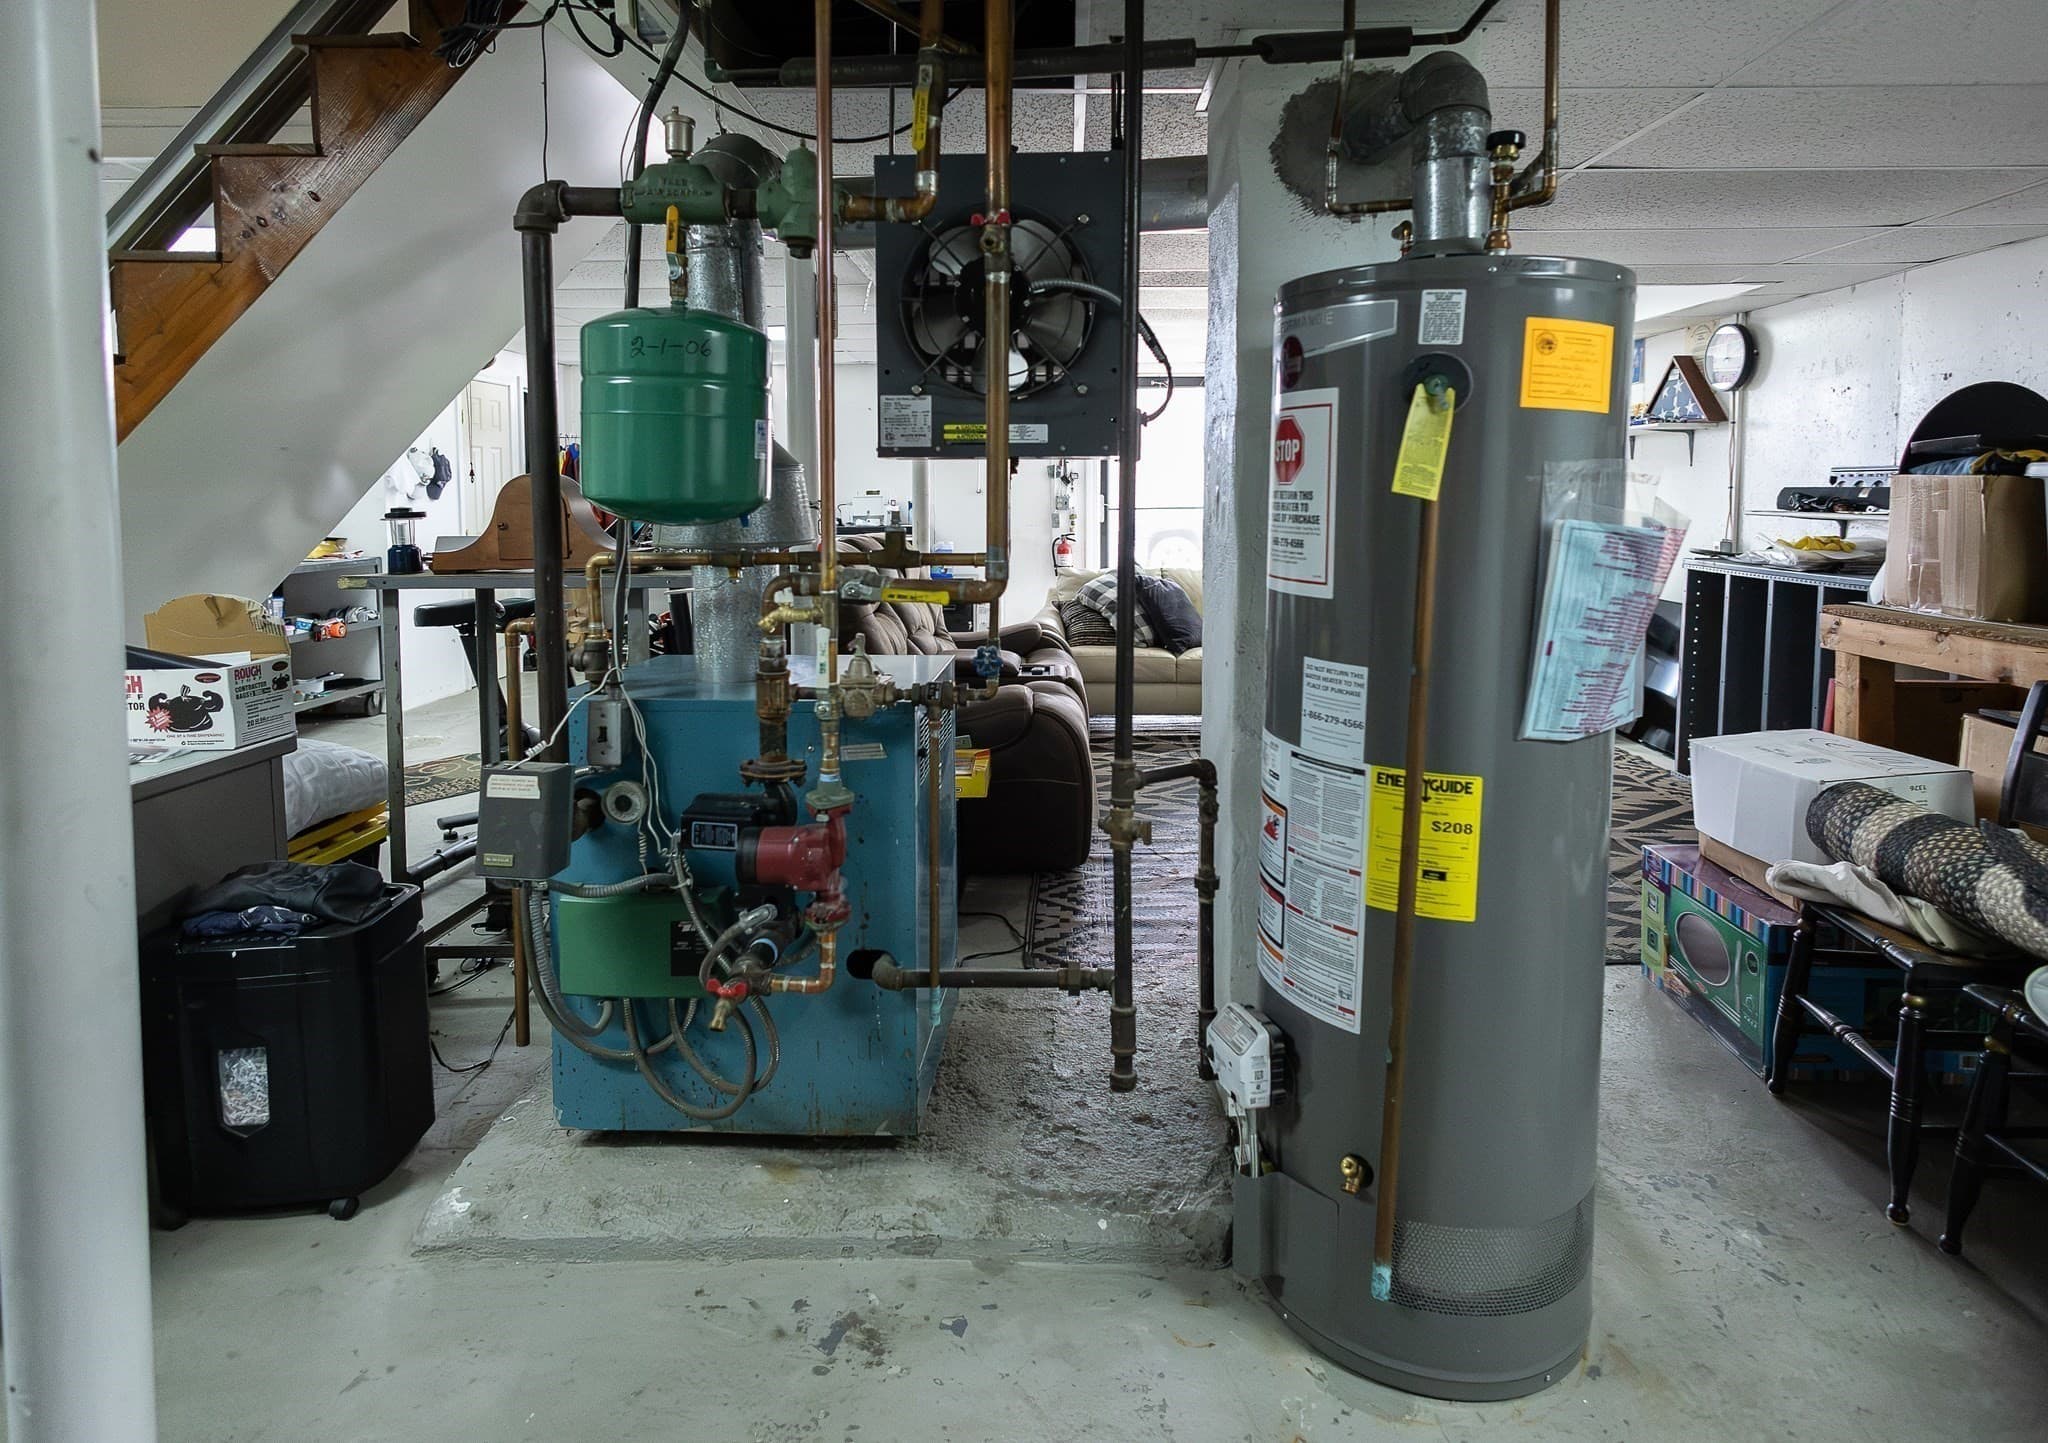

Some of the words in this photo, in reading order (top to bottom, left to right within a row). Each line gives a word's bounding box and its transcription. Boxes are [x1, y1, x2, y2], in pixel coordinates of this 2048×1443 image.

[631, 335, 712, 358] 2-1-06
[1275, 439, 1300, 462] STOP
[234, 664, 262, 681] ROUGH
[1376, 771, 1474, 795] ENEYGUIDE
